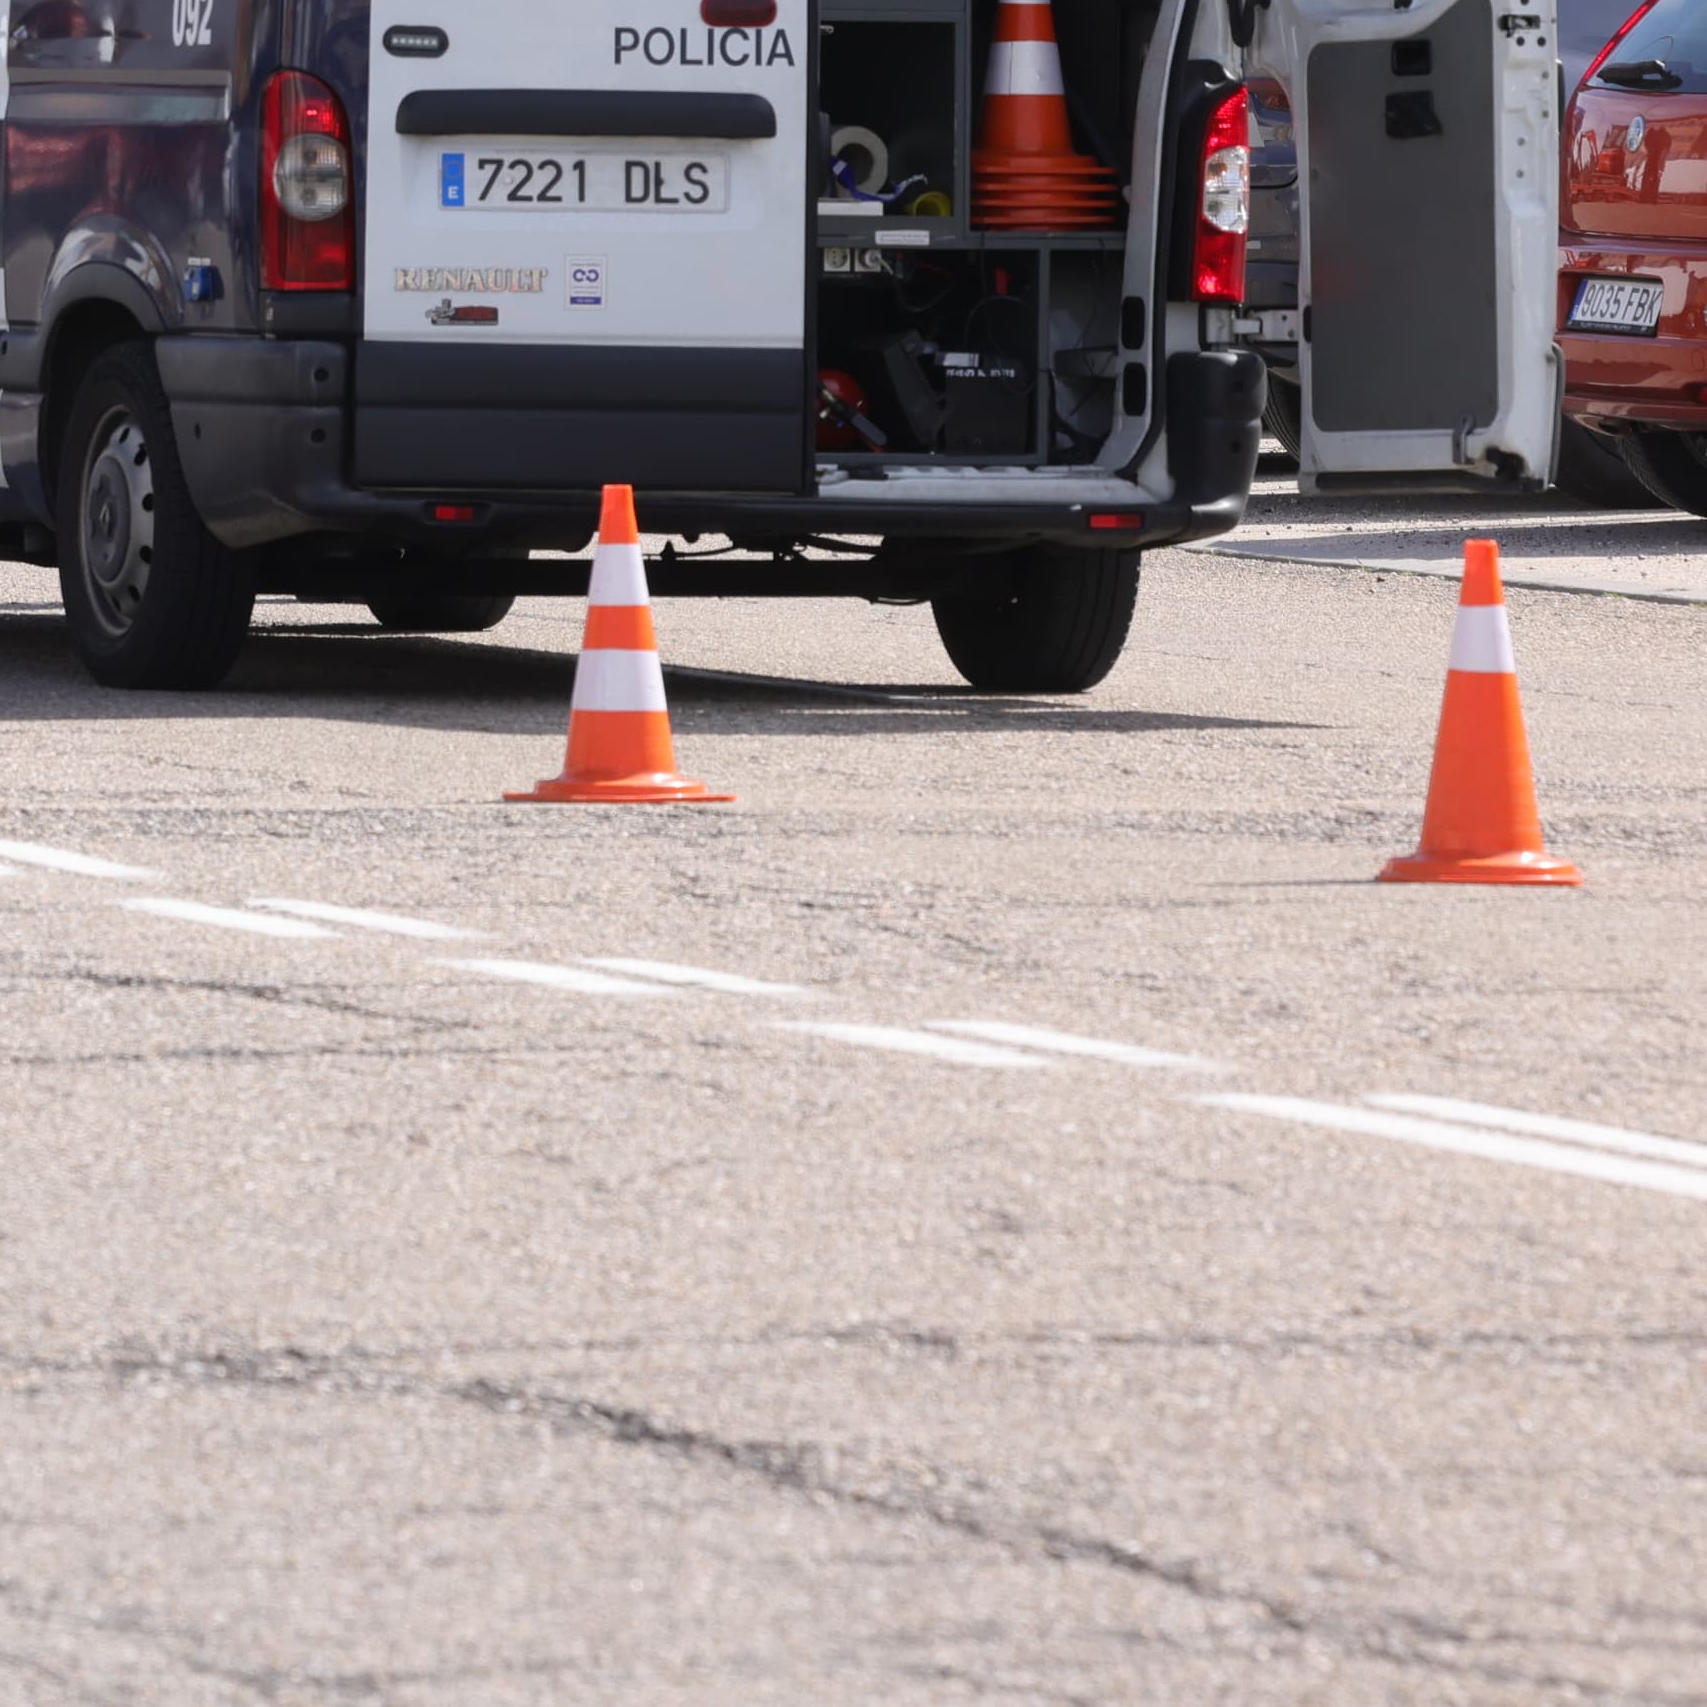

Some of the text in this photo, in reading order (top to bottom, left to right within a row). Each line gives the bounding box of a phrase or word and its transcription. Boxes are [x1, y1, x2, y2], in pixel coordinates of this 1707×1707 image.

[614, 26, 796, 67] POLICIA
[478, 158, 586, 203] 7221
[624, 160, 710, 205] DLS
[394, 267, 549, 293] RENAULT
[1581, 283, 1663, 325] 9035 FBK
